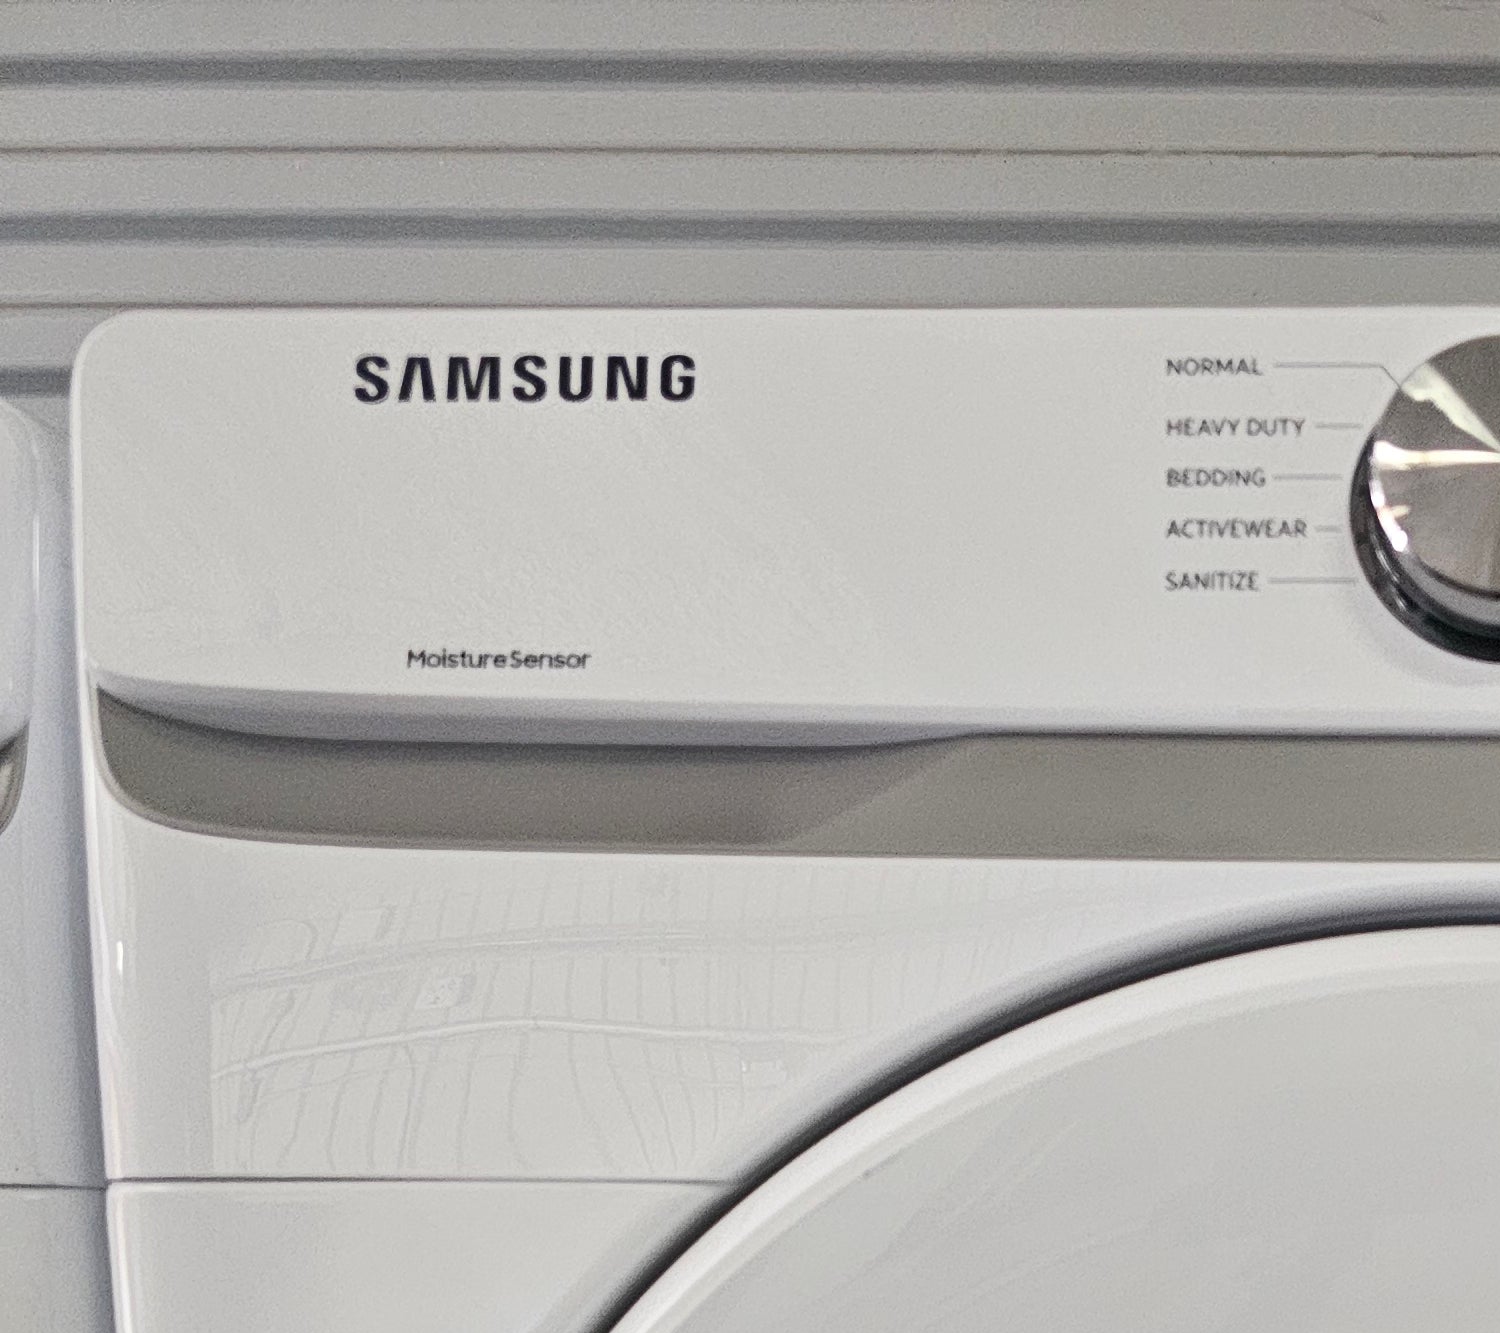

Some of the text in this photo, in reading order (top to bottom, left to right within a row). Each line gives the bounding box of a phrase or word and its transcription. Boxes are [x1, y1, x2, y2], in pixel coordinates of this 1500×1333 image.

[1166, 357, 1262, 377] NORMAL
[354, 354, 696, 404] SAMSUNG
[1166, 416, 1306, 438] HEAVY DUTY
[1166, 467, 1266, 488] BEDDING
[1166, 517, 1308, 539] ACTIVEWEAR
[1165, 570, 1258, 591] SANITIZE
[406, 648, 593, 670] Moisture Sensor
